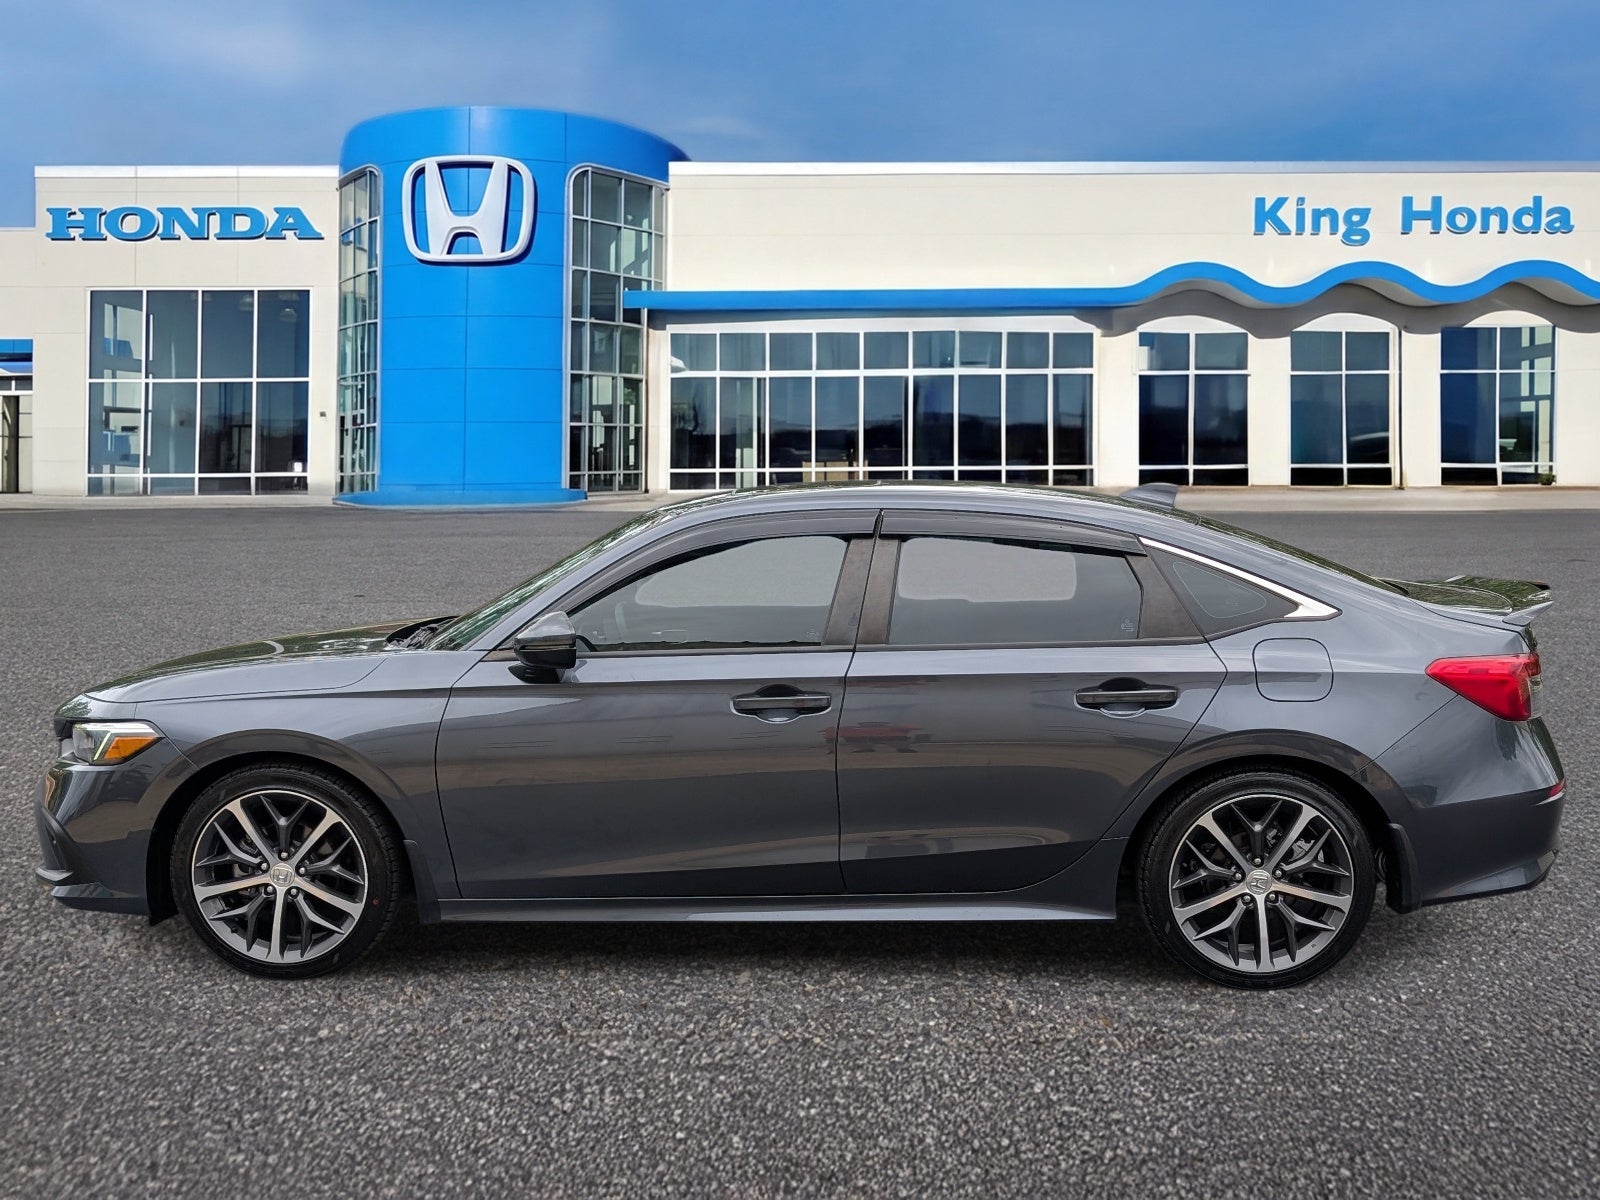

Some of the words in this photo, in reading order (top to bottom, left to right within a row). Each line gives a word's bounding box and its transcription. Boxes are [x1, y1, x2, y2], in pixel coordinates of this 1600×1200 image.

[46, 206, 324, 241] HONDA
[1253, 196, 1372, 246] King
[1401, 195, 1574, 235] Honda
